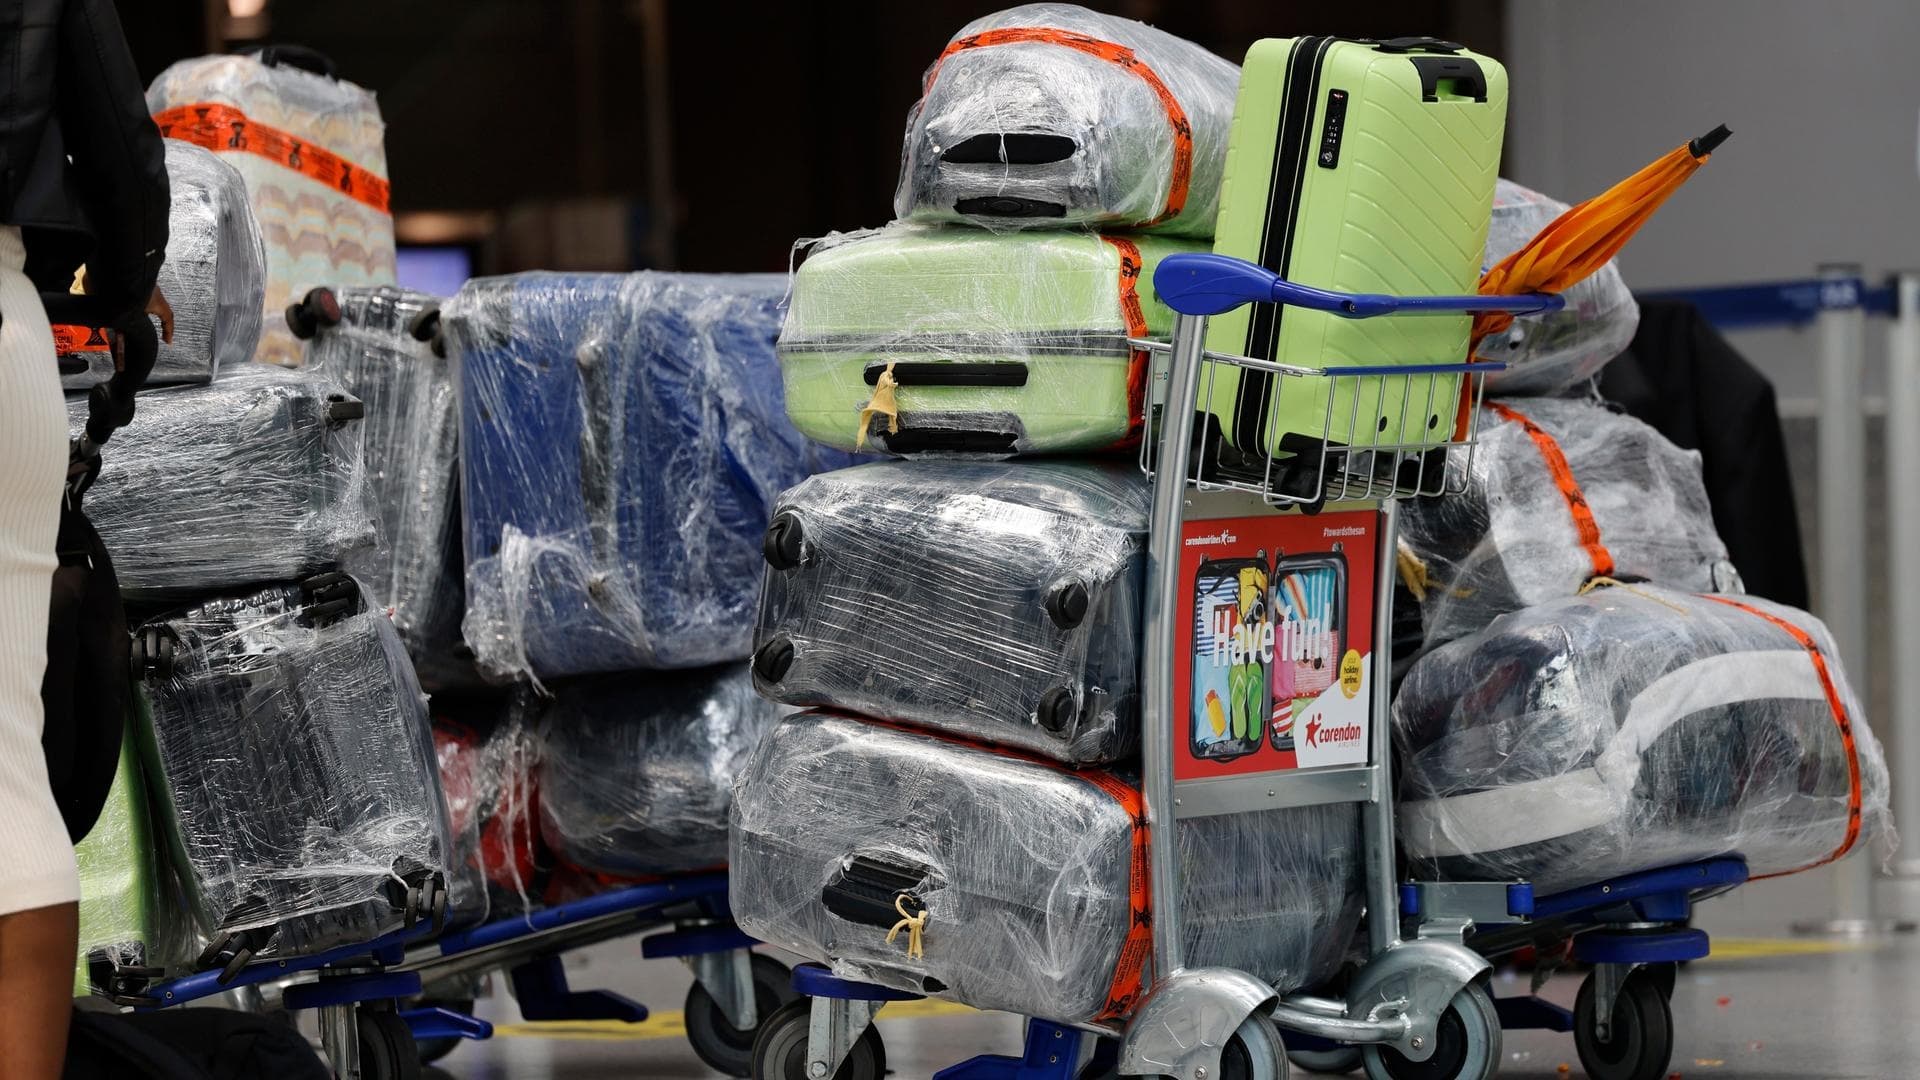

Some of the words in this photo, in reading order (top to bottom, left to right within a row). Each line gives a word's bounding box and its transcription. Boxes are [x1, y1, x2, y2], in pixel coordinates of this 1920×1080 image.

[1212, 610, 1275, 668] Have
[1281, 602, 1331, 662] fun!
[1319, 721, 1361, 743] corendon
